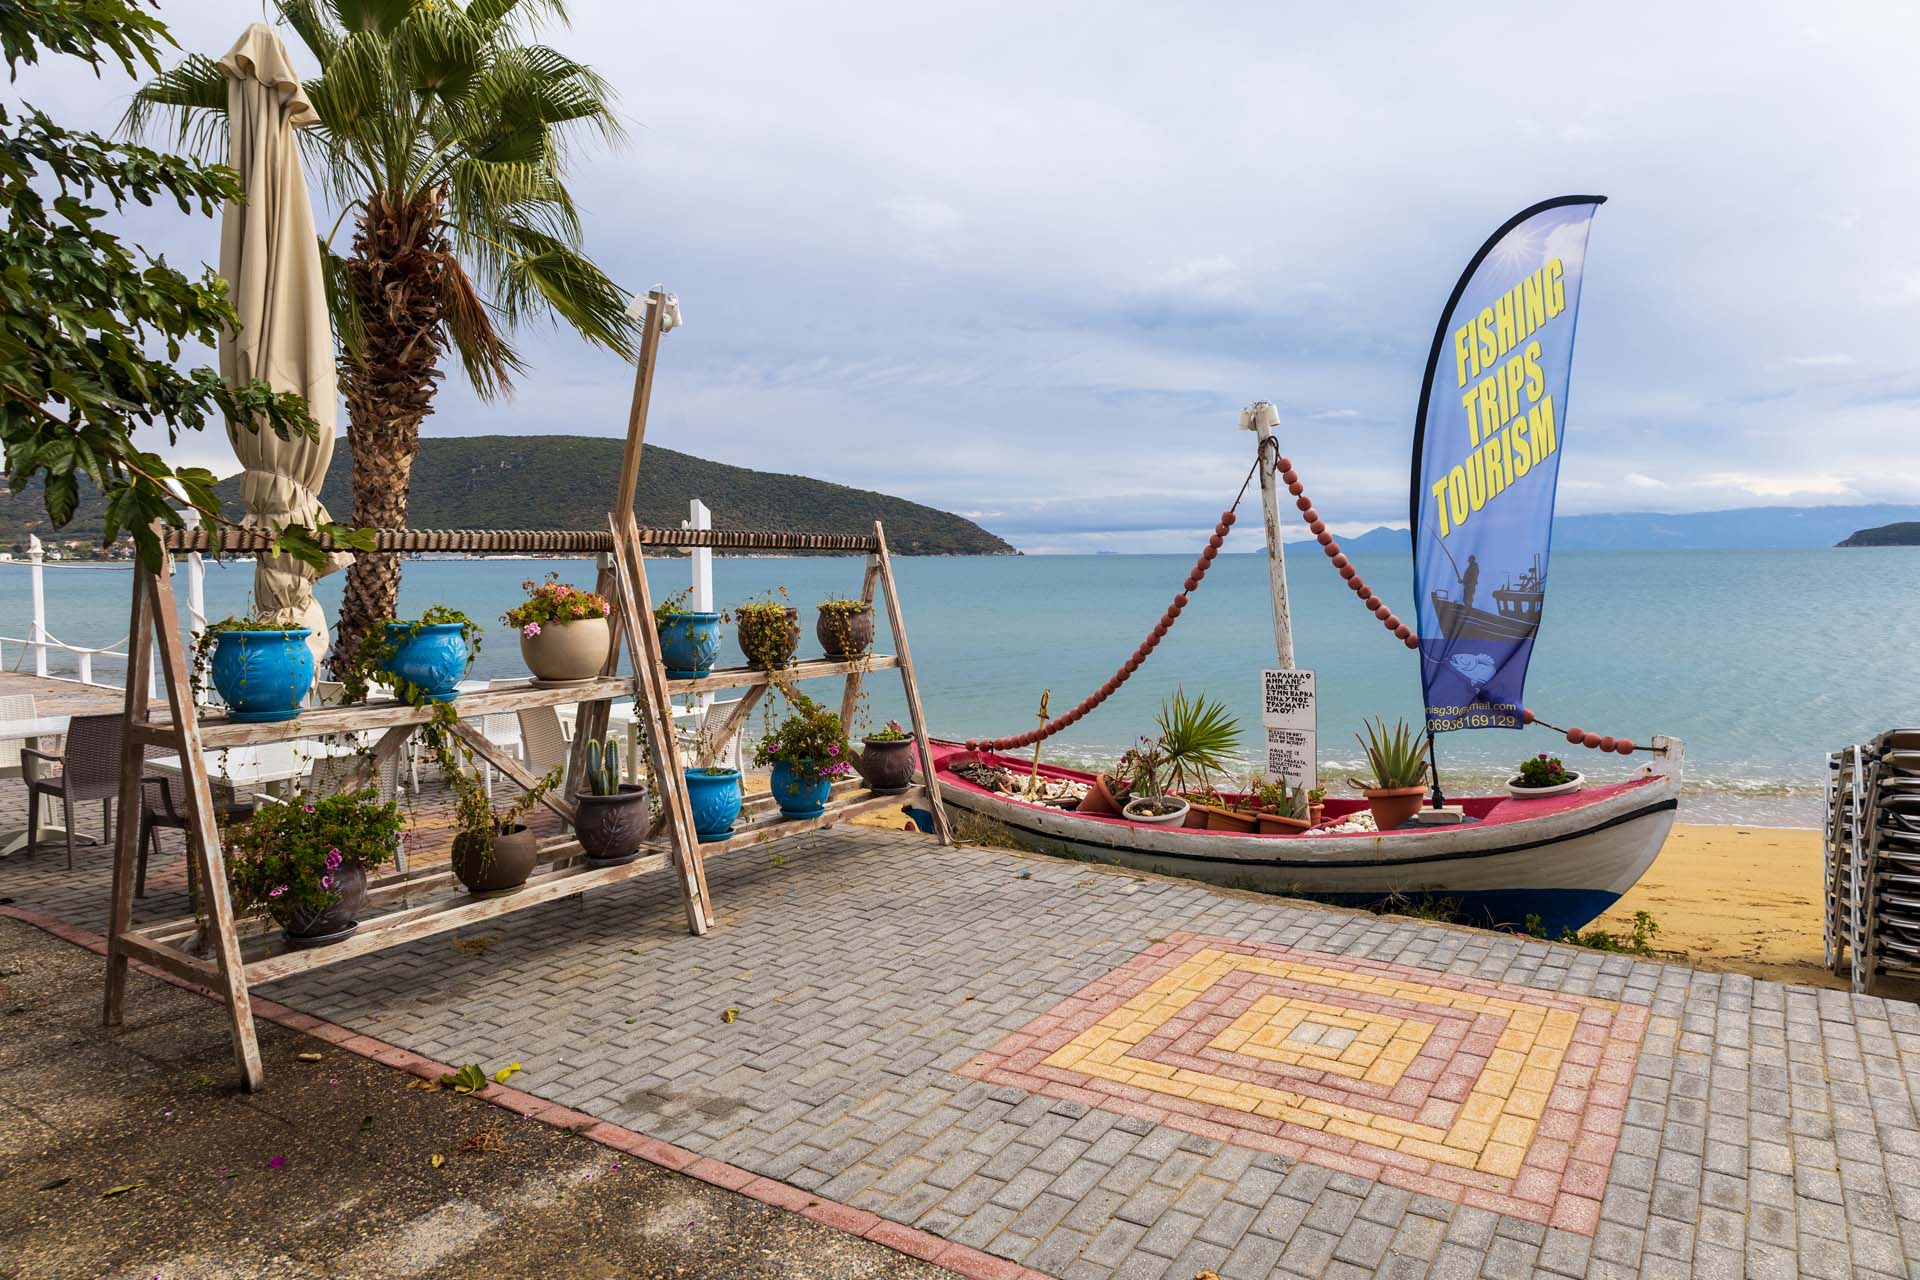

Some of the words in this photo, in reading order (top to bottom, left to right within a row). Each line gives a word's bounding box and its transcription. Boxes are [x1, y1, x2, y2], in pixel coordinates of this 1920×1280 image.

[1454, 257, 1566, 388] FISHING
[1461, 340, 1545, 449] TRIPS
[1431, 395, 1558, 539] TOURISM
[1266, 696, 1309, 704] ΚΙΝΔΥΝΟΣ
